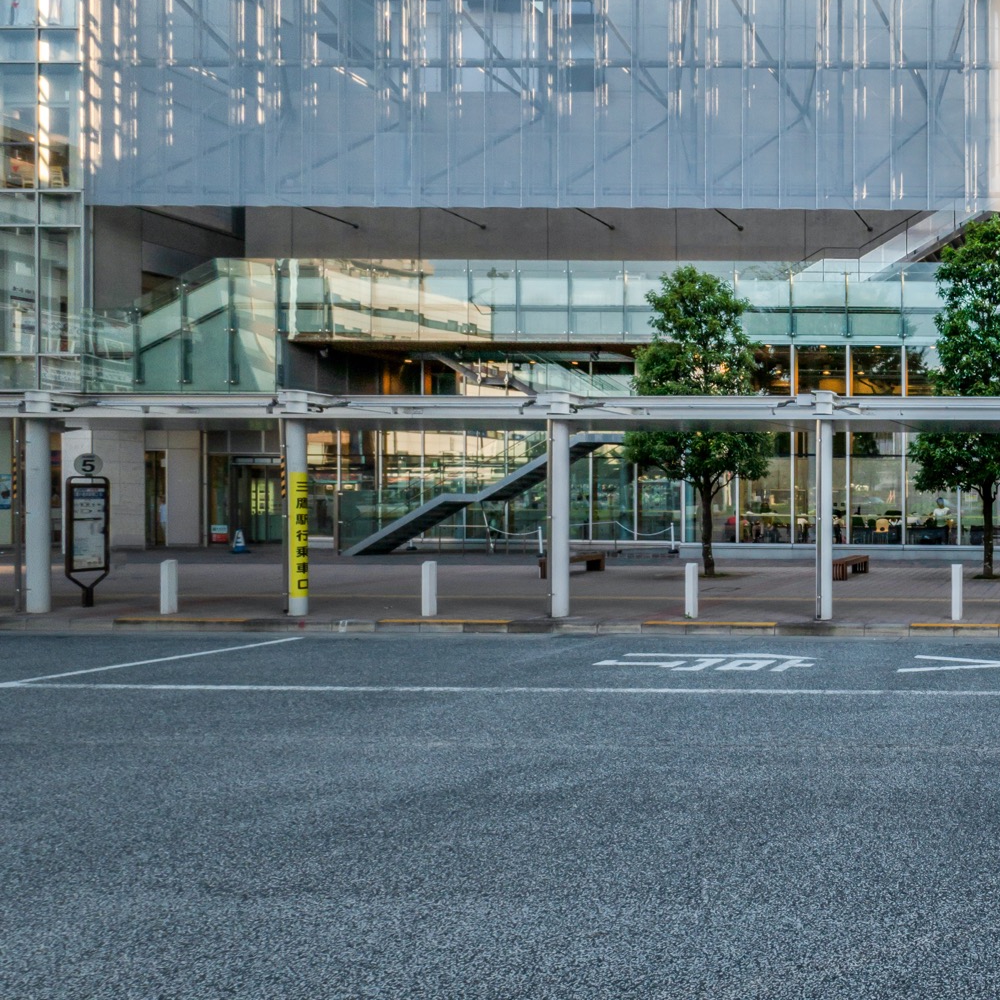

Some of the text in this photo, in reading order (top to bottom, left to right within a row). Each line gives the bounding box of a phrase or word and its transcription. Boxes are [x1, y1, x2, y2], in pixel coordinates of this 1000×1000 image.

[82, 459, 95, 472] 5
[296, 481, 308, 590] 三鷹駅行乗車口
